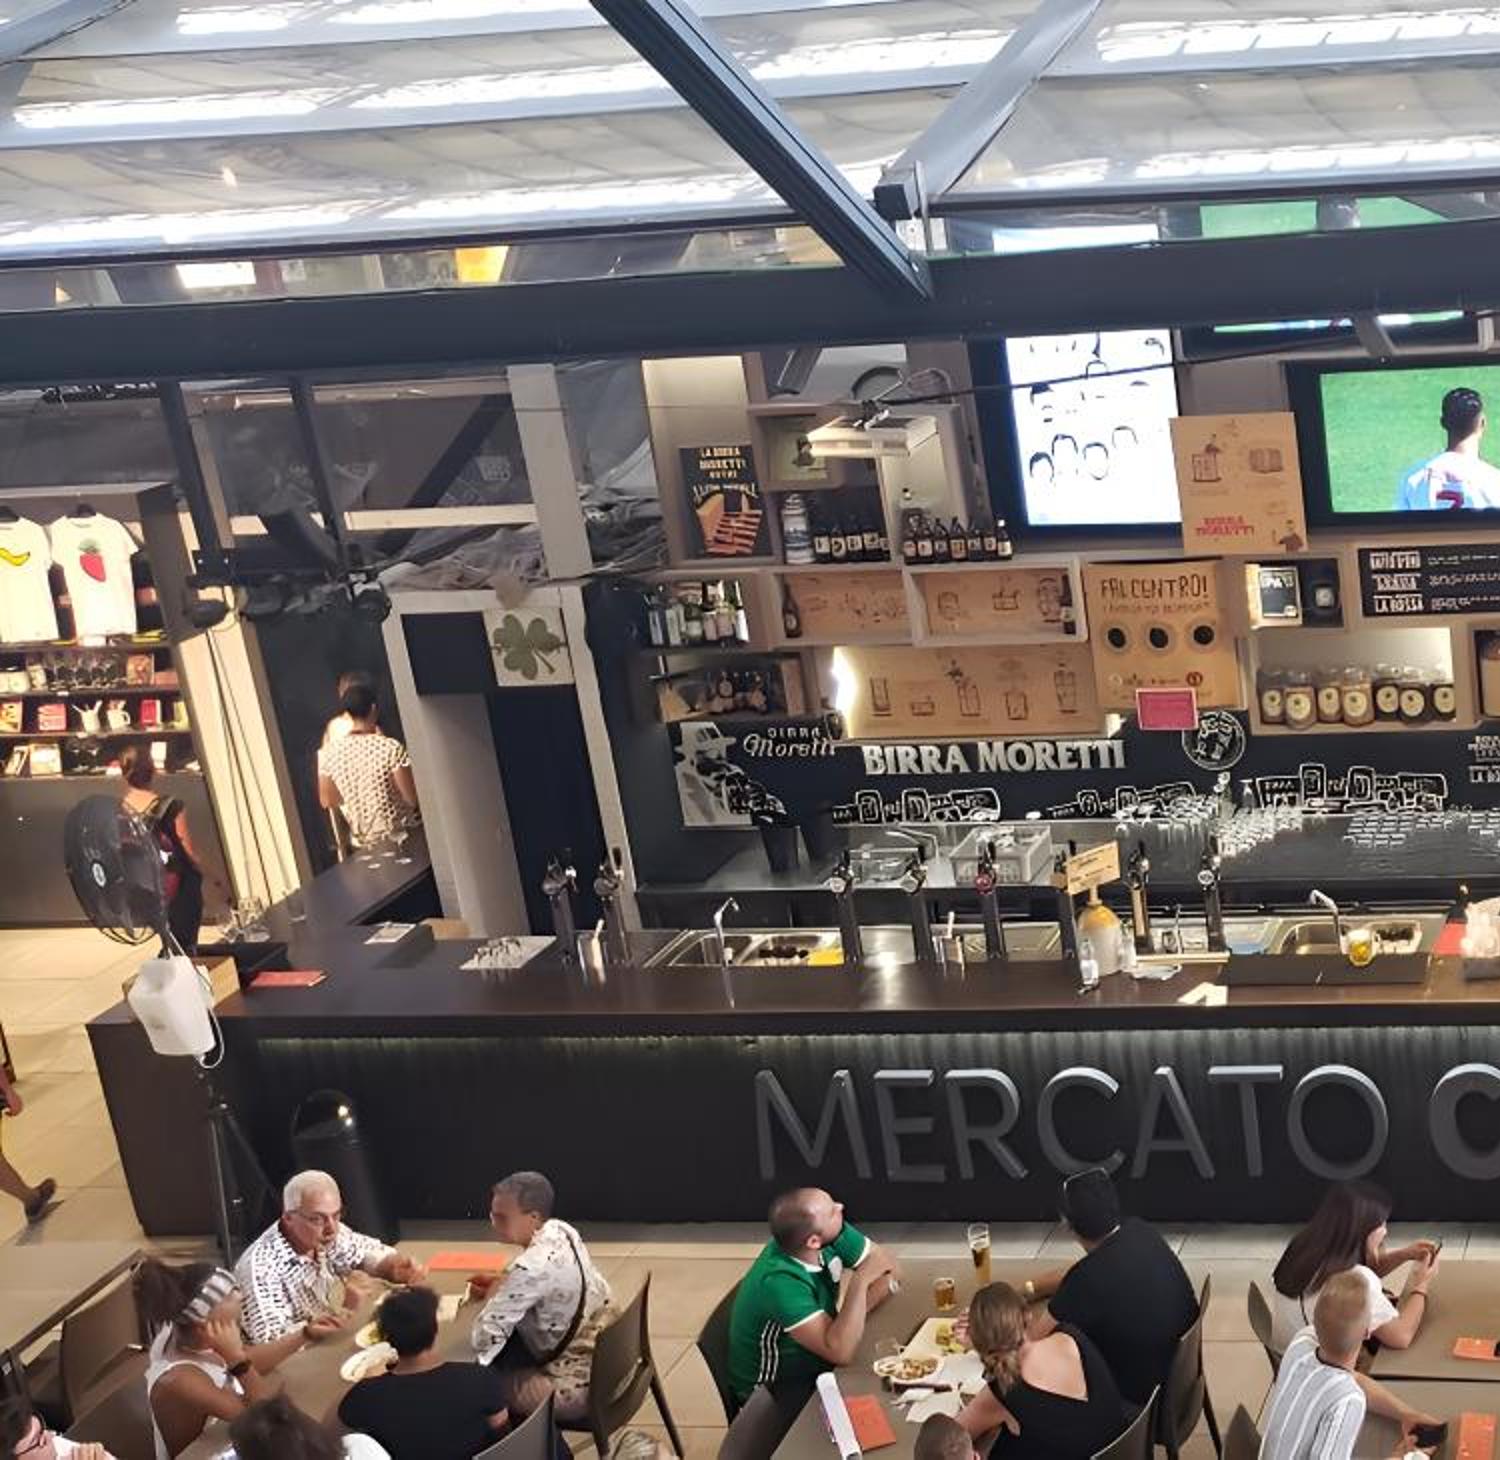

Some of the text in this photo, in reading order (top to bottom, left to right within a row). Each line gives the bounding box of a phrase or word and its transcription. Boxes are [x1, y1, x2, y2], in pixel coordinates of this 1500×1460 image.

[743, 732, 836, 759] Moretti
[861, 740, 1128, 775] BIRRA MORETTI
[753, 1064, 1391, 1183] MERCATO
